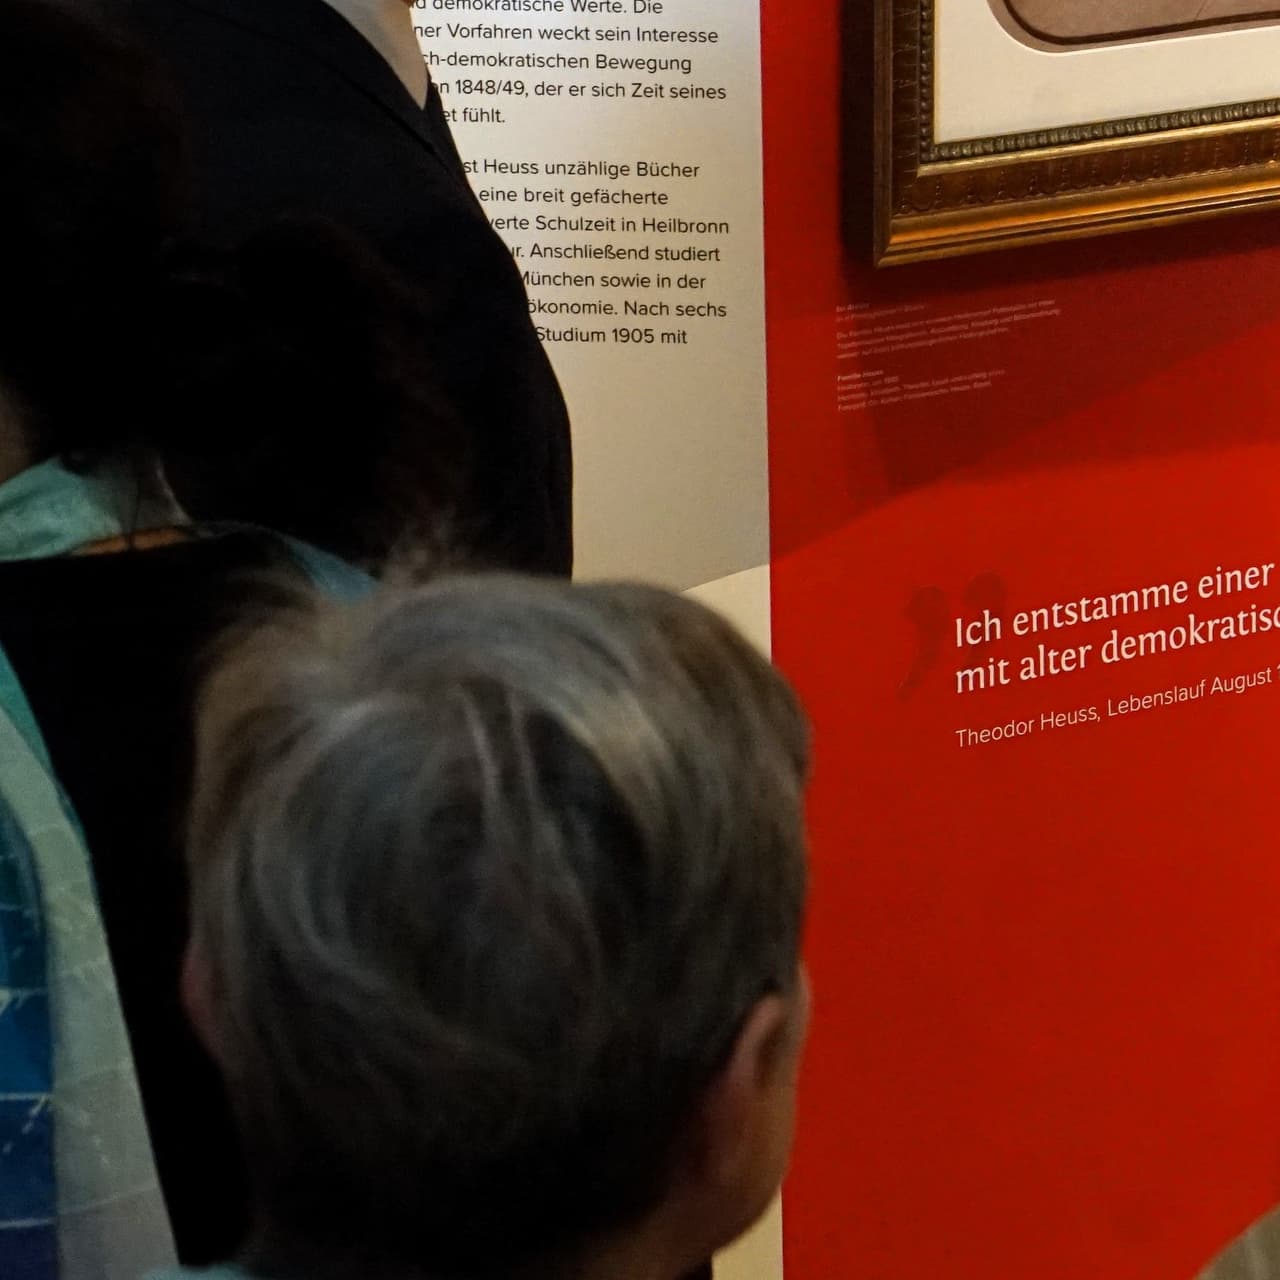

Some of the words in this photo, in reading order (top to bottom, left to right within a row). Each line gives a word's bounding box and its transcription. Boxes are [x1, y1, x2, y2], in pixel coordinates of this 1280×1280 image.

[446, 22, 533, 41] Vorfahren
[537, 25, 591, 41] weckt
[594, 26, 631, 42] sein
[636, 26, 719, 44] Interesse
[595, 53, 692, 75] Bewegung
[455, 78, 529, 99] 1848/49,
[533, 80, 564, 97] der
[568, 84, 587, 97] er
[591, 81, 626, 98] sich
[631, 82, 665, 99] Zeit
[669, 83, 727, 100] seines
[461, 106, 506, 124] fühlt.
[483, 158, 540, 177] Heuss
[544, 160, 631, 180] unzählige
[636, 161, 701, 178] Bücher
[478, 186, 519, 203] eine
[523, 186, 566, 205] breit
[570, 187, 669, 208] gefächerte
[535, 214, 617, 232] Schulzeit
[621, 216, 637, 233] in
[642, 217, 729, 235] Heilbronn
[529, 242, 650, 261] Anschließend
[654, 245, 721, 262] studiert
[600, 272, 652, 289] sowie
[656, 273, 672, 289] in
[676, 273, 707, 289] der
[527, 298, 618, 317] ökonomie.
[624, 300, 670, 317] Nach
[675, 301, 727, 318] sechs
[536, 326, 606, 343] Studium
[611, 327, 655, 344] 1905
[660, 329, 688, 345] mit
[955, 609, 1002, 648] Ich
[1012, 580, 1189, 636] entstamme
[1197, 562, 1275, 599] einer
[955, 657, 1011, 694] mit
[1019, 643, 1093, 681] alter
[955, 719, 1036, 748] Theodor
[1040, 706, 1101, 731] Heuss,
[1107, 678, 1207, 717] Lebenslauf
[1209, 666, 1273, 695] August
